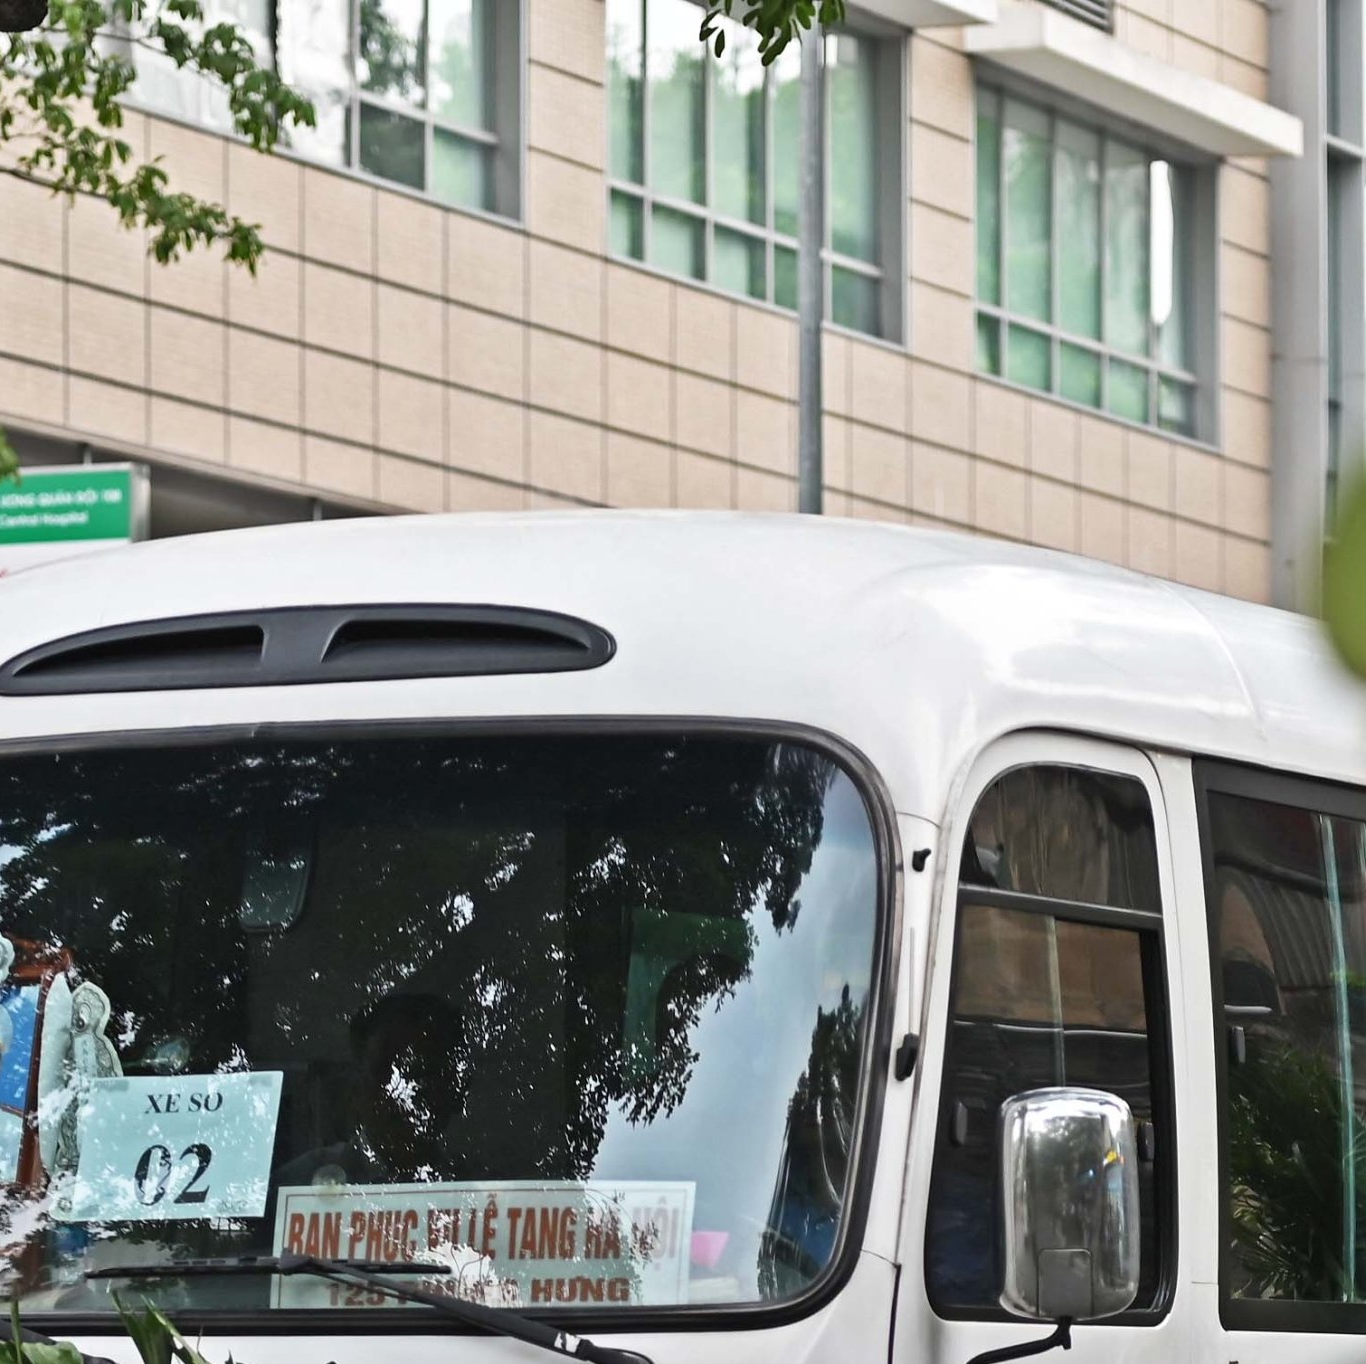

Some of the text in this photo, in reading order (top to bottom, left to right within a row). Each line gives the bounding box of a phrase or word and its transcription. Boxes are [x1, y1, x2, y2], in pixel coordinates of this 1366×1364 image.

[144, 1092, 182, 1115] XE
[134, 1142, 213, 1207] 02
[507, 1206, 578, 1260] TANG
